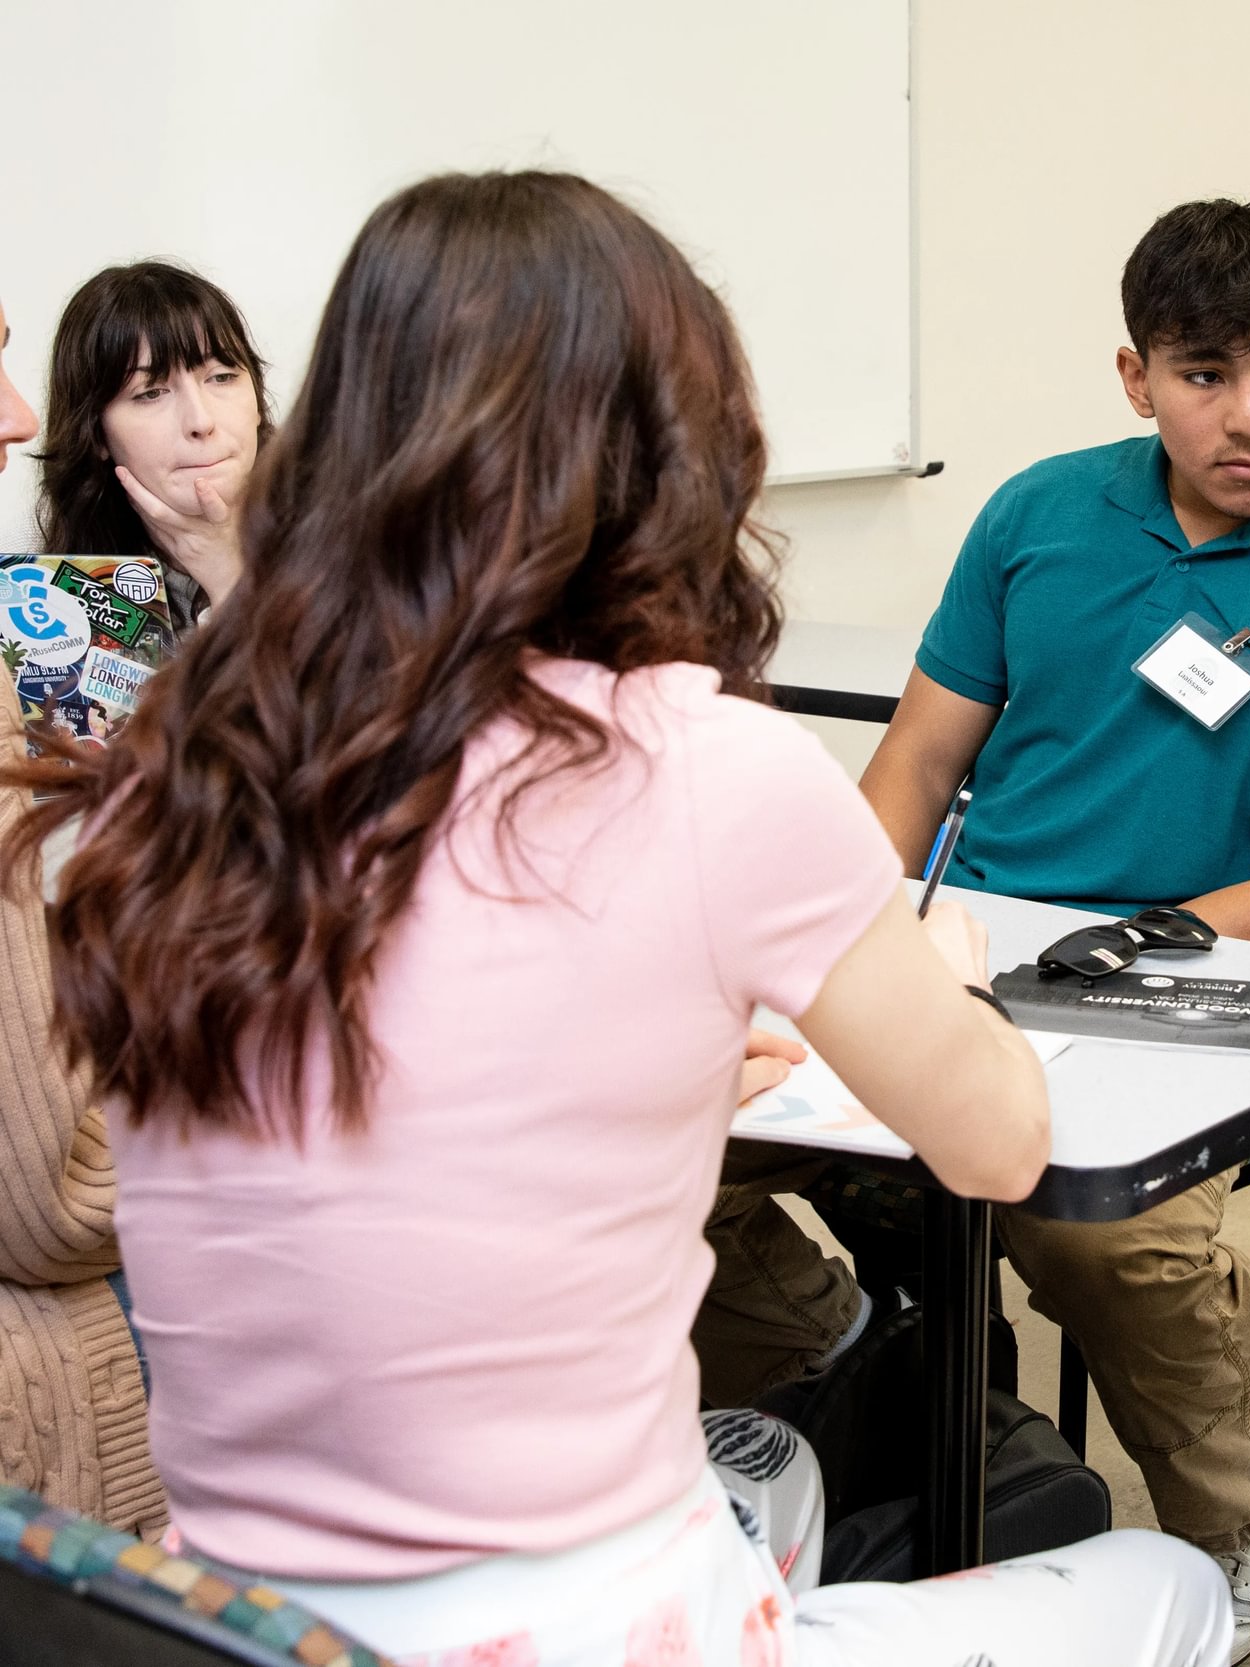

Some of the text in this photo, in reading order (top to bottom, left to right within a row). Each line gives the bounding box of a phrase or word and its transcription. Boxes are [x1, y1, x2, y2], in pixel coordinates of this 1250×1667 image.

[90, 600, 129, 615] A
[1188, 663, 1215, 686] Joshua
[67, 712, 84, 720] 1839
[1082, 995, 1191, 1009] UNIVERSITY
